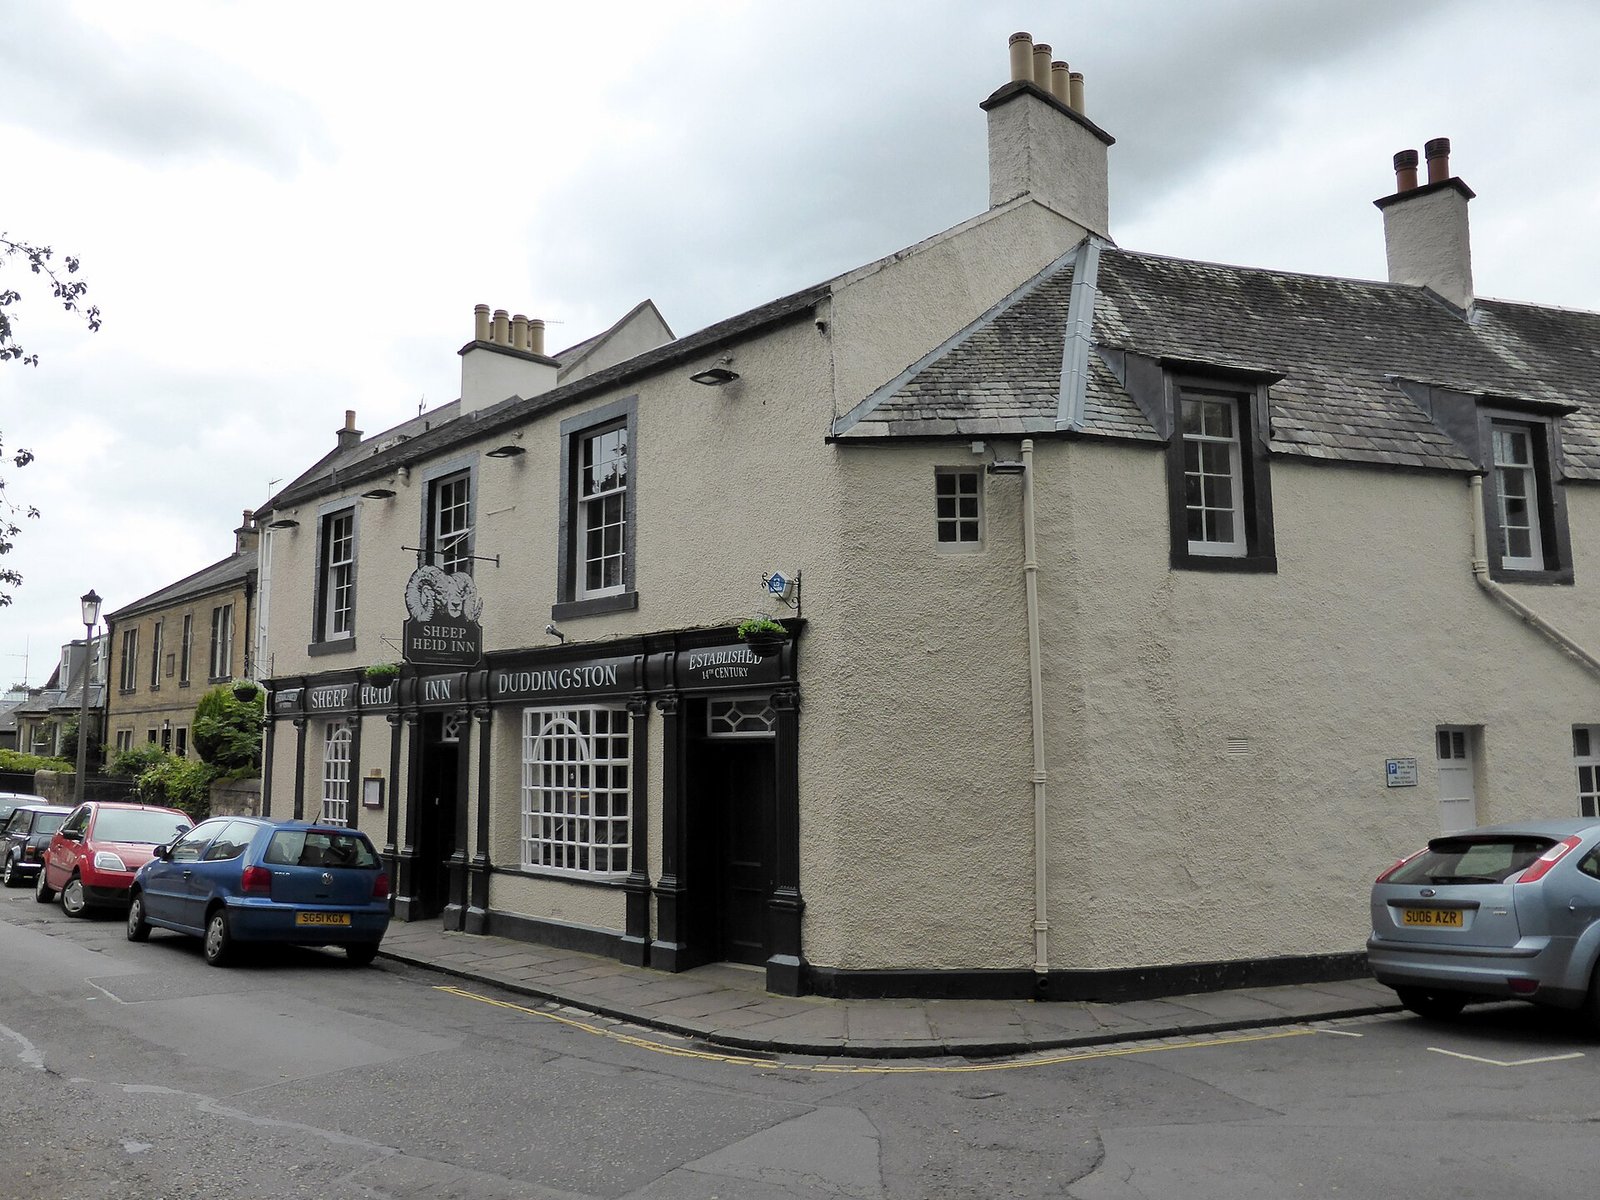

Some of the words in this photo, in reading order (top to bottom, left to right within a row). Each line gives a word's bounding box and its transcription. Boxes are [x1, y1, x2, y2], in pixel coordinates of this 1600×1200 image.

[423, 625, 467, 639] SHEEP
[413, 637, 447, 651] HEID
[452, 640, 475, 652] INN
[689, 649, 762, 671] ESTABLISHED
[715, 666, 749, 679] CENTURY
[312, 688, 348, 709] SHEEP
[361, 686, 392, 705] HEID
[425, 679, 451, 701] INN
[499, 664, 617, 694] DUDDINGSTON
[303, 912, 325, 924] SG51
[327, 913, 344, 924] KGX
[1406, 910, 1432, 923] SU06
[1435, 911, 1457, 924] AZR
